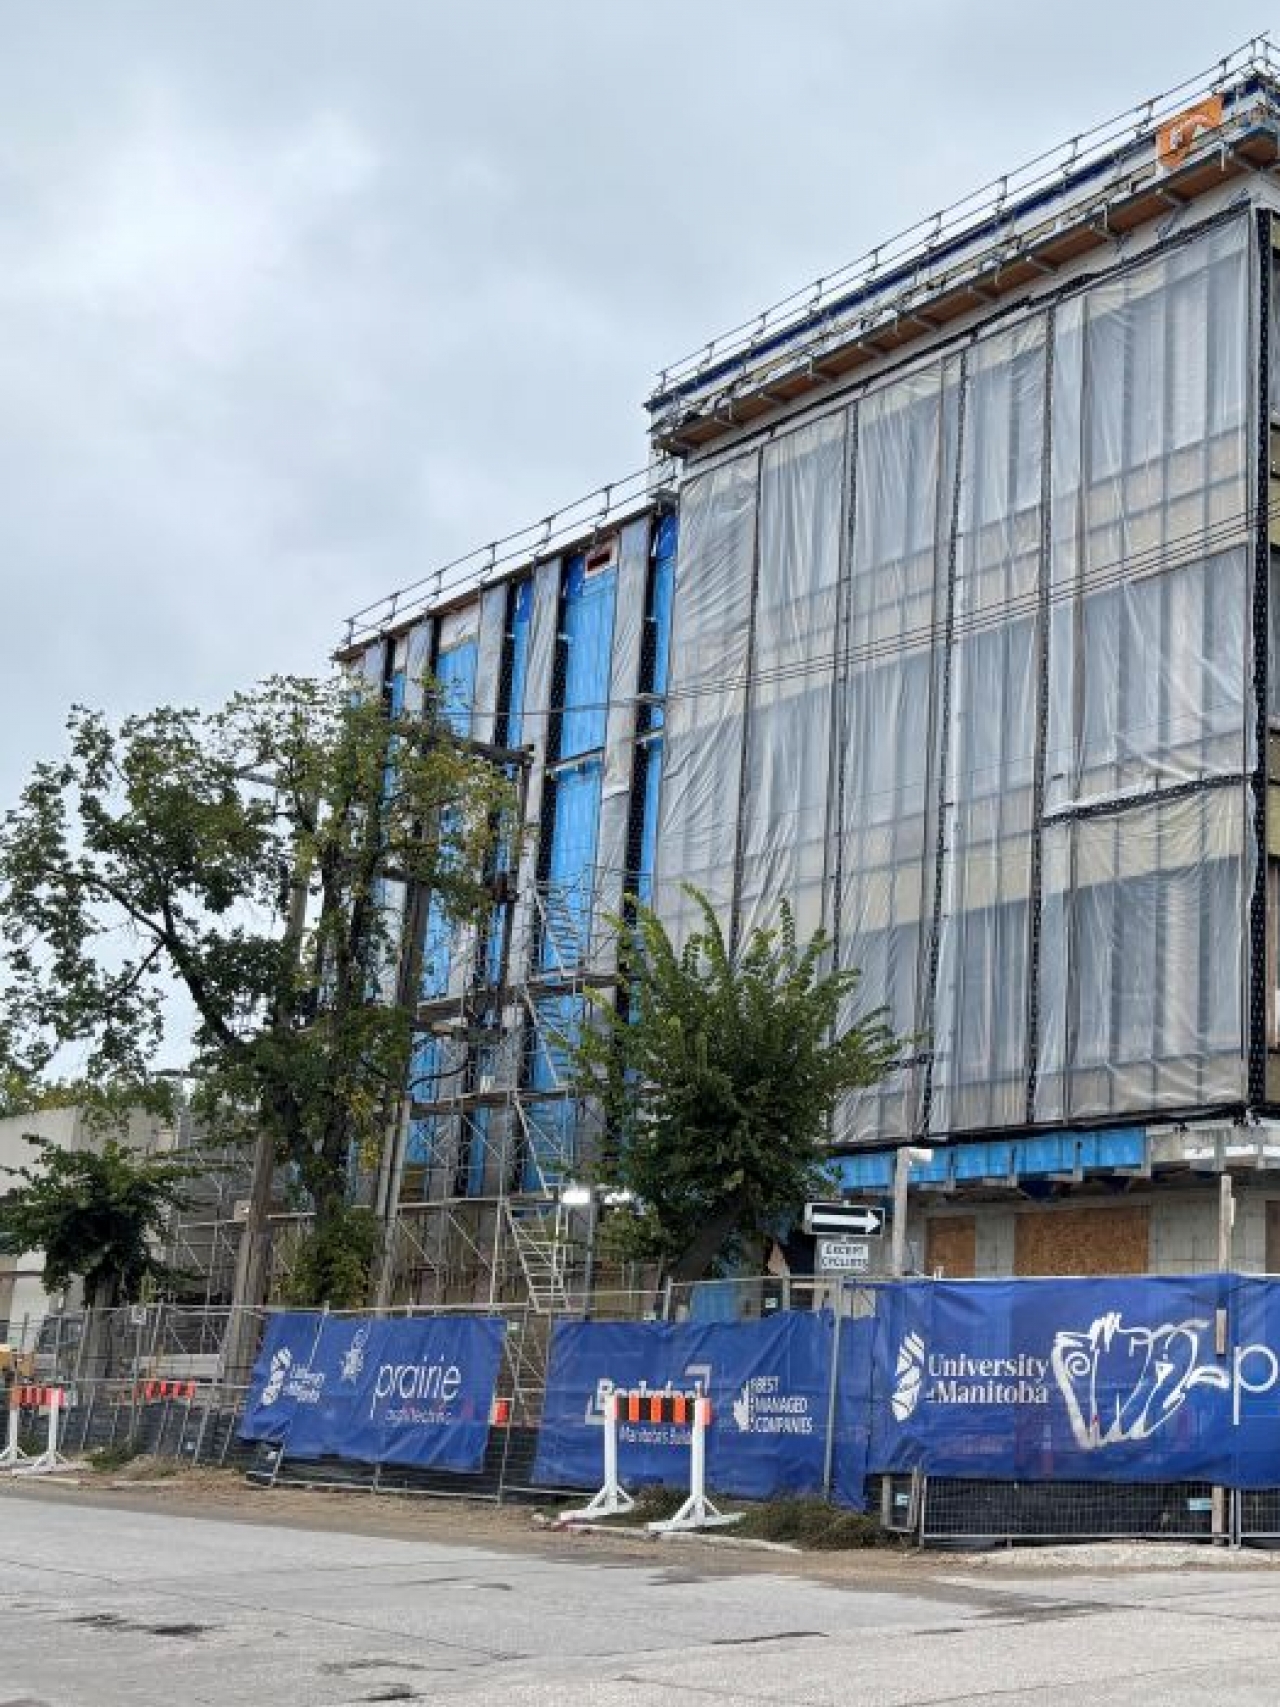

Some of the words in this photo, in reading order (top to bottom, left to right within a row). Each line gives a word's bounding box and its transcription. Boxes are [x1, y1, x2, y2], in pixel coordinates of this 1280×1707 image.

[928, 1353, 1049, 1383] University
[370, 1354, 461, 1421] prairie
[937, 1379, 1049, 1404] Manitoba
[756, 1397, 808, 1413] MANAGED
[756, 1417, 813, 1434] COMPANIES
